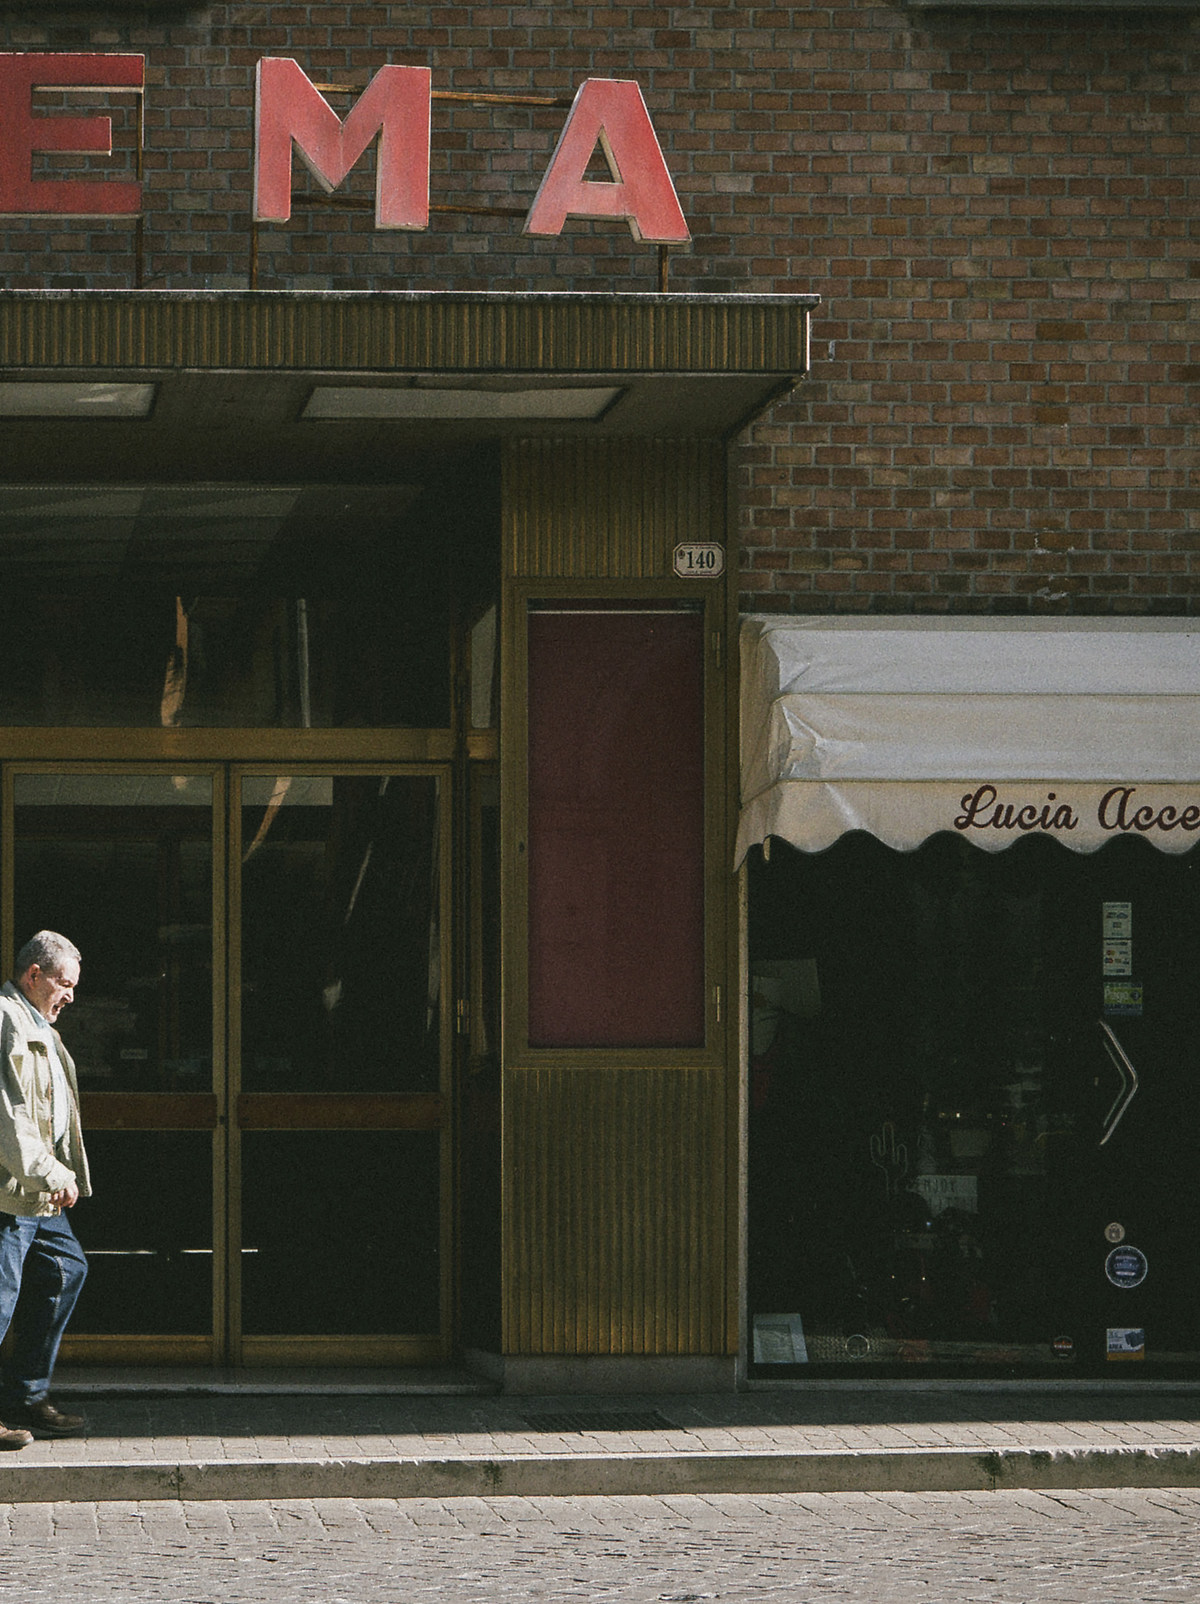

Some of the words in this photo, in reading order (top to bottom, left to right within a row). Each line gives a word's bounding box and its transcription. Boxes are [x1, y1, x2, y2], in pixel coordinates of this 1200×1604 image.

[686, 550, 715, 569] 140
[953, 784, 1079, 831] Lucia
[1097, 786, 1200, 832] Acce
